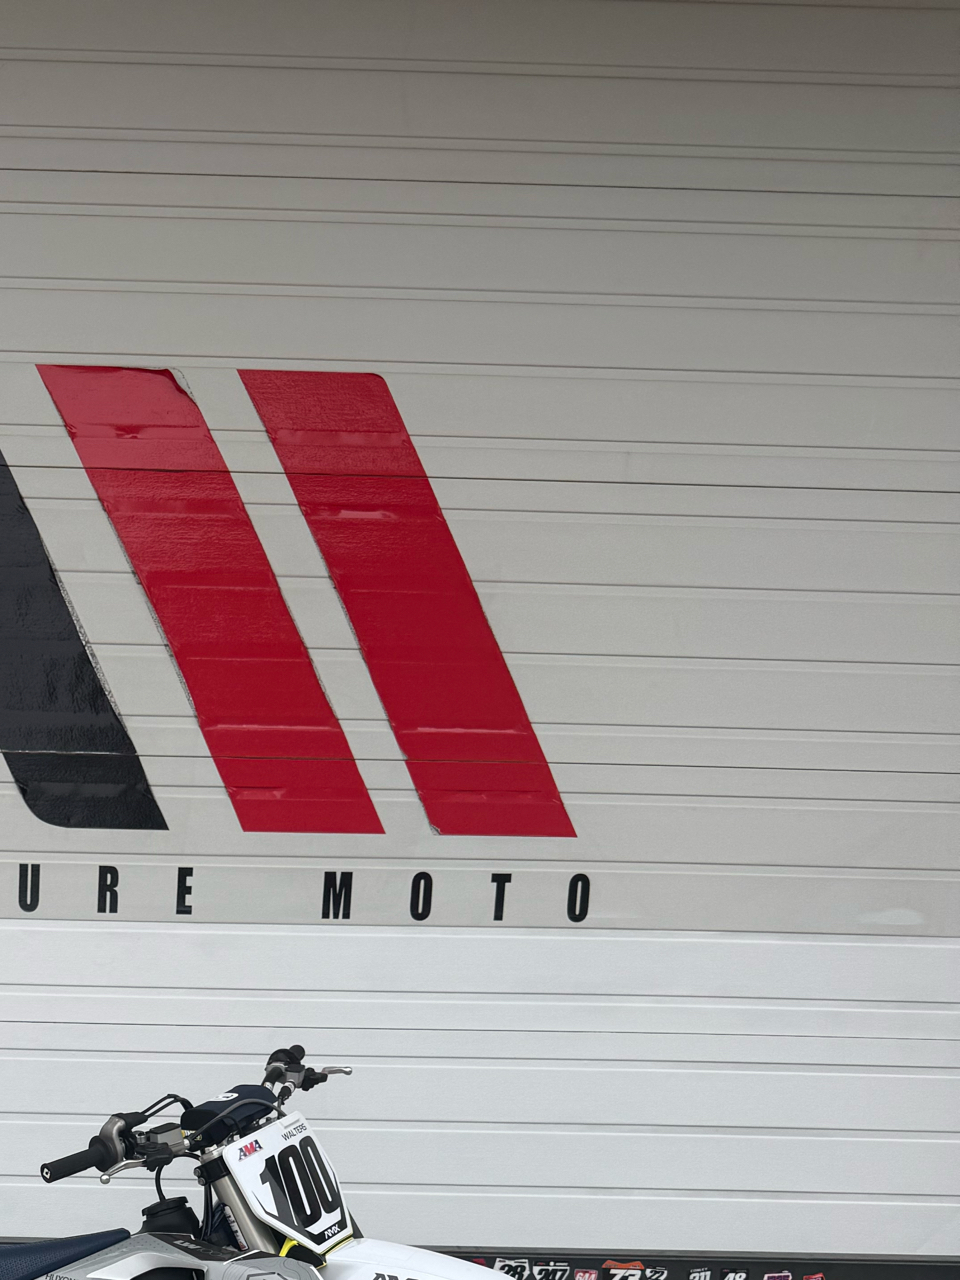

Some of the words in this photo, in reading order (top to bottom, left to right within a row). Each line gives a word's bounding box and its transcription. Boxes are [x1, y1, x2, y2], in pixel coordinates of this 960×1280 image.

[321, 871, 591, 923] MOTO
[238, 1139, 263, 1161] AMA
[259, 1135, 341, 1229] 100
[324, 1224, 341, 1239] AMX
